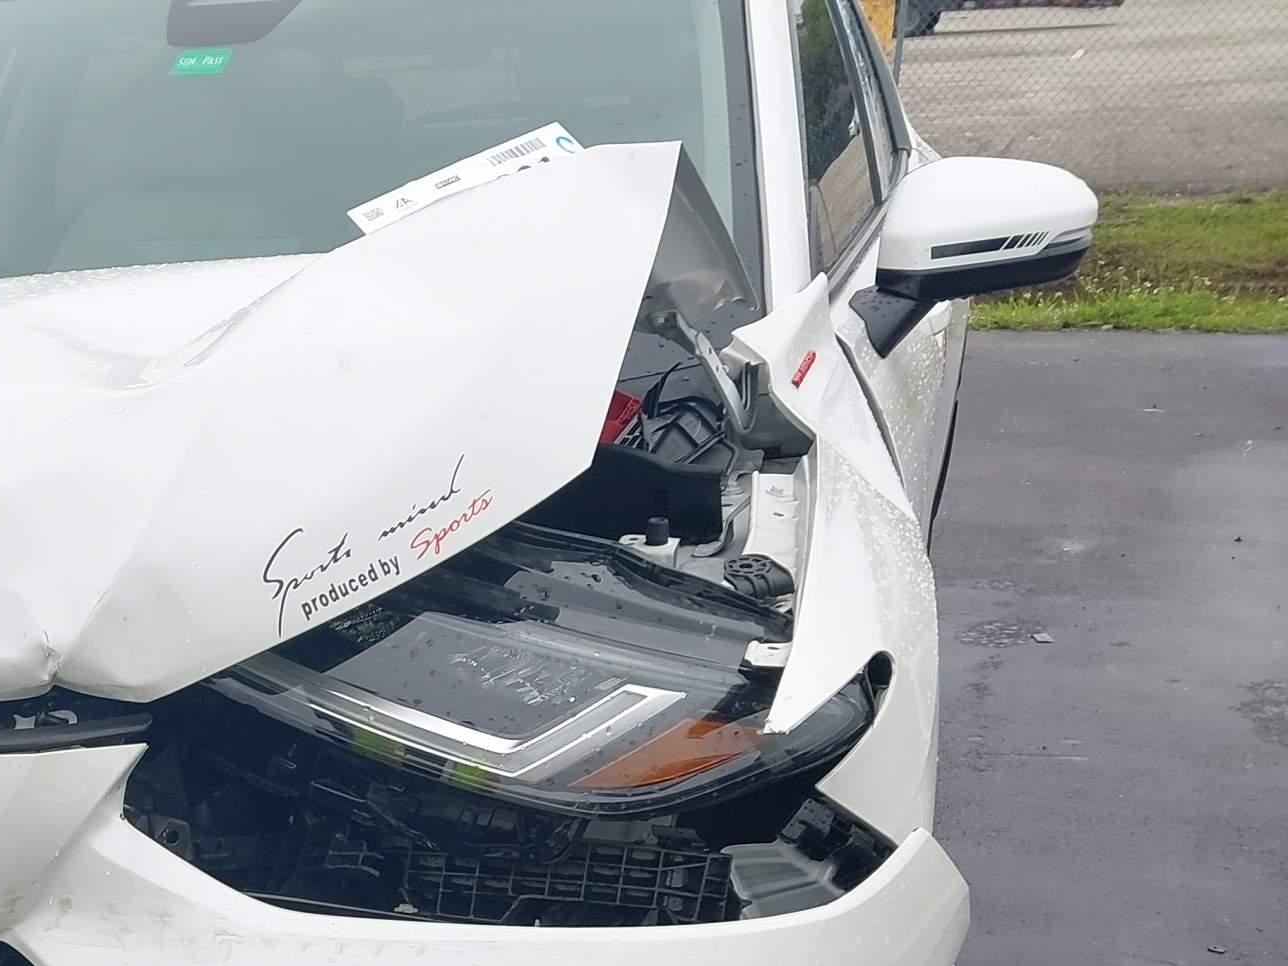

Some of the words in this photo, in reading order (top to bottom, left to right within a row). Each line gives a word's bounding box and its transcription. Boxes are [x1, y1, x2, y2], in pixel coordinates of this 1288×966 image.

[262, 527, 352, 638] Sports
[377, 453, 465, 542] mind
[300, 563, 380, 620] produced
[378, 555, 401, 576] by
[410, 488, 494, 560] Sports
